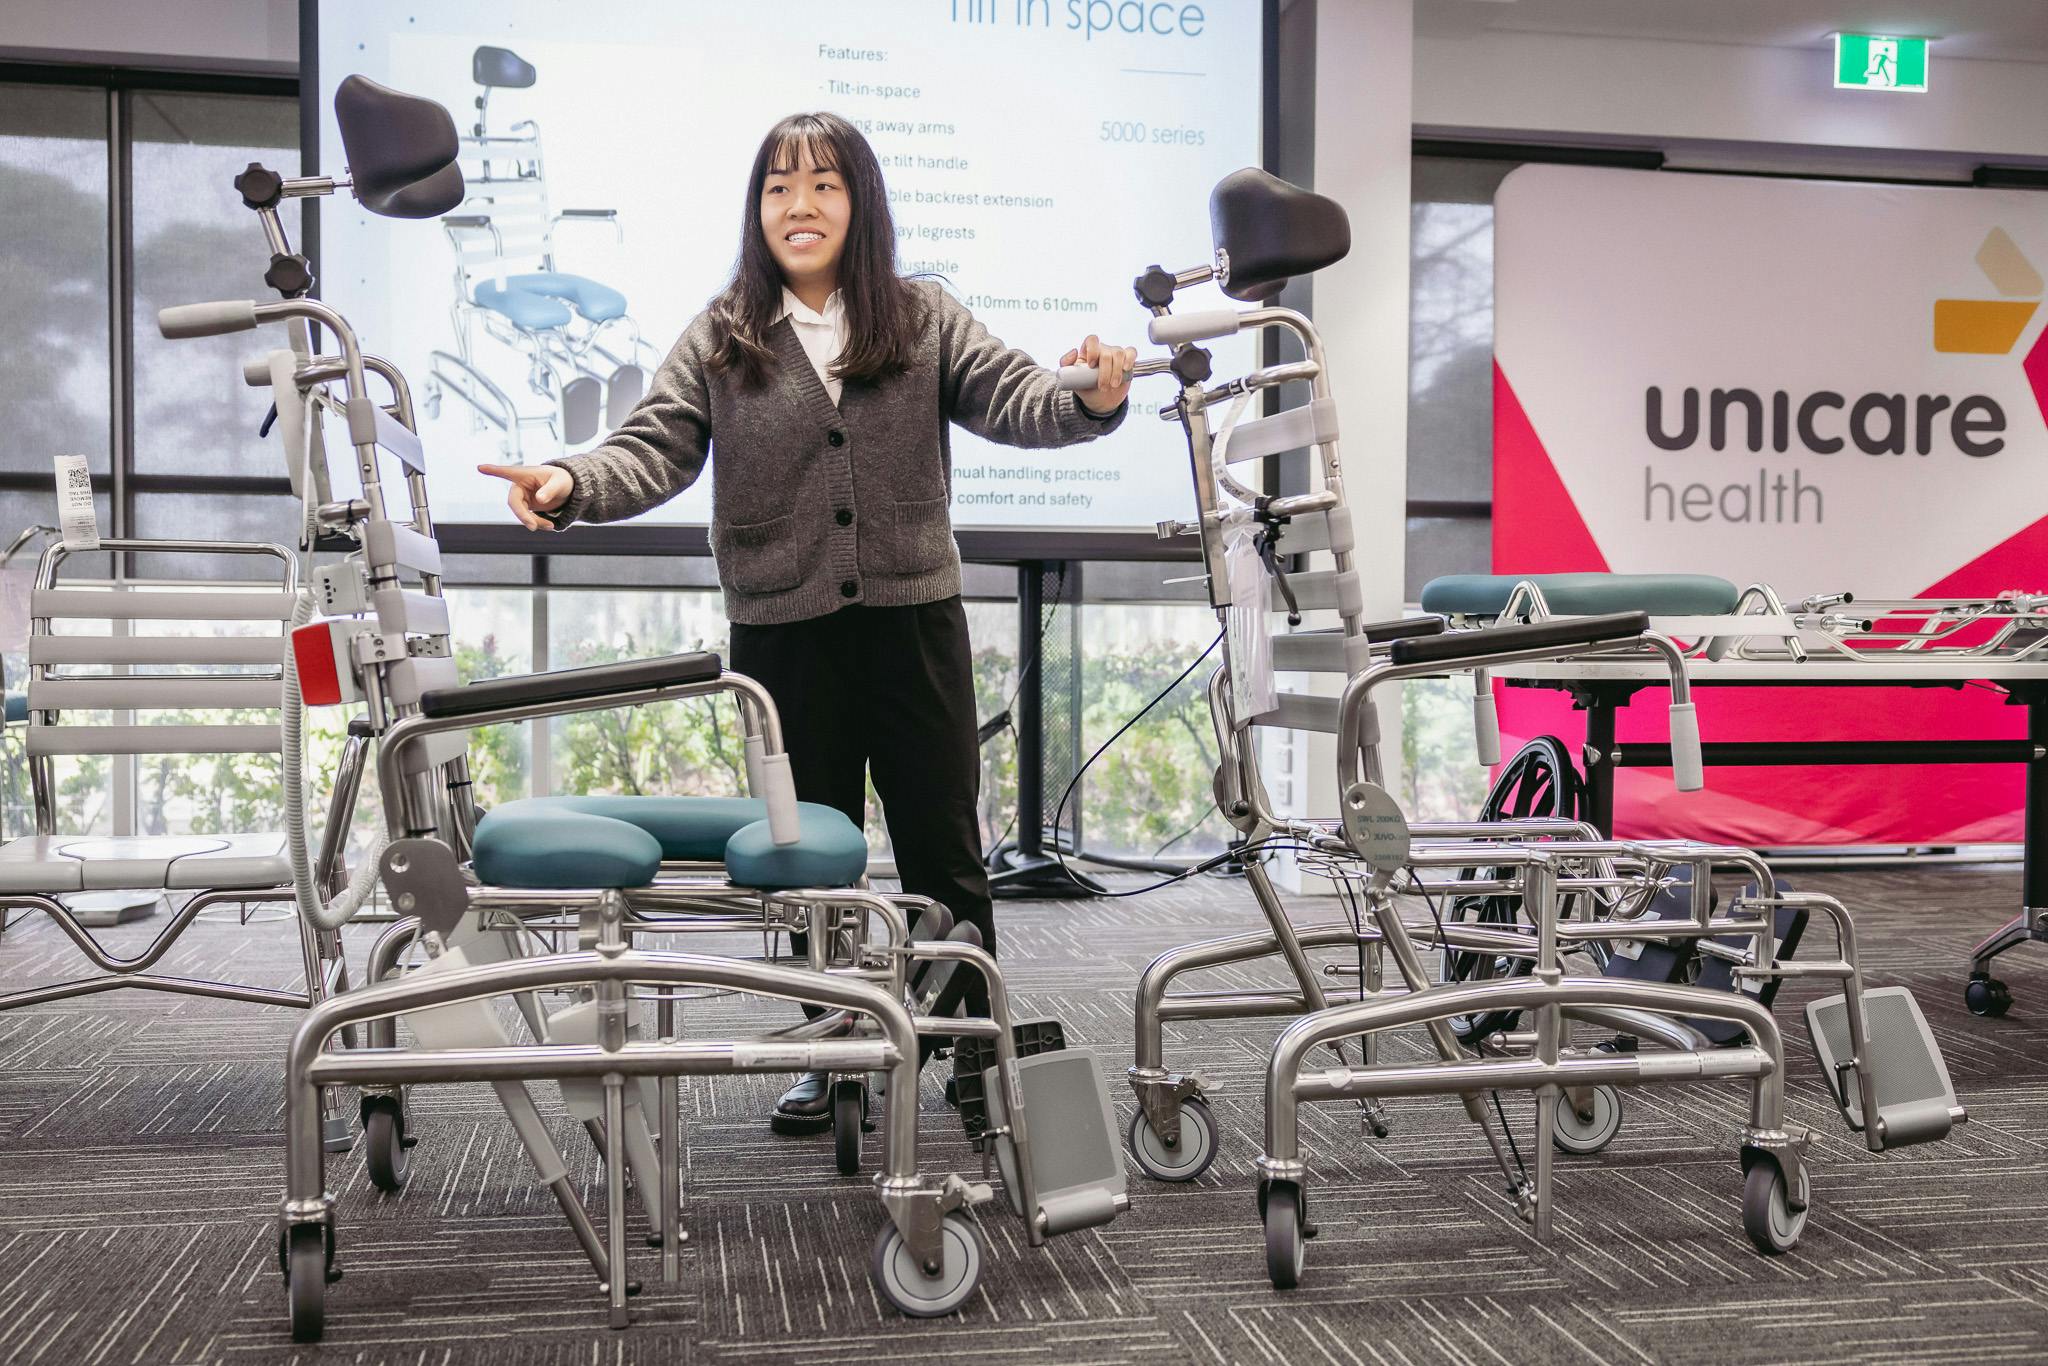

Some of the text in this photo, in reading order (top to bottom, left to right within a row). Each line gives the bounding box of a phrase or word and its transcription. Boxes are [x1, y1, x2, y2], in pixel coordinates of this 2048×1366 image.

[1066, 0, 1205, 41] space
[818, 44, 888, 62] Features:
[828, 80, 921, 98] Tilt-in-space
[876, 121, 914, 136] away
[918, 122, 955, 136] arms
[1099, 120, 1206, 146] 5000 series
[894, 154, 913, 168] tilt
[917, 155, 969, 171] handle
[915, 189, 979, 206] backrest
[983, 193, 1054, 209] extension
[917, 224, 976, 242] legrests
[1026, 298, 1040, 311] to
[1043, 297, 1098, 312] 610mm
[1645, 385, 2007, 457] unicare
[988, 465, 1051, 484] handling
[1055, 468, 1121, 483] practices
[957, 491, 1093, 509] comfort and safety
[1645, 465, 1823, 523] health
